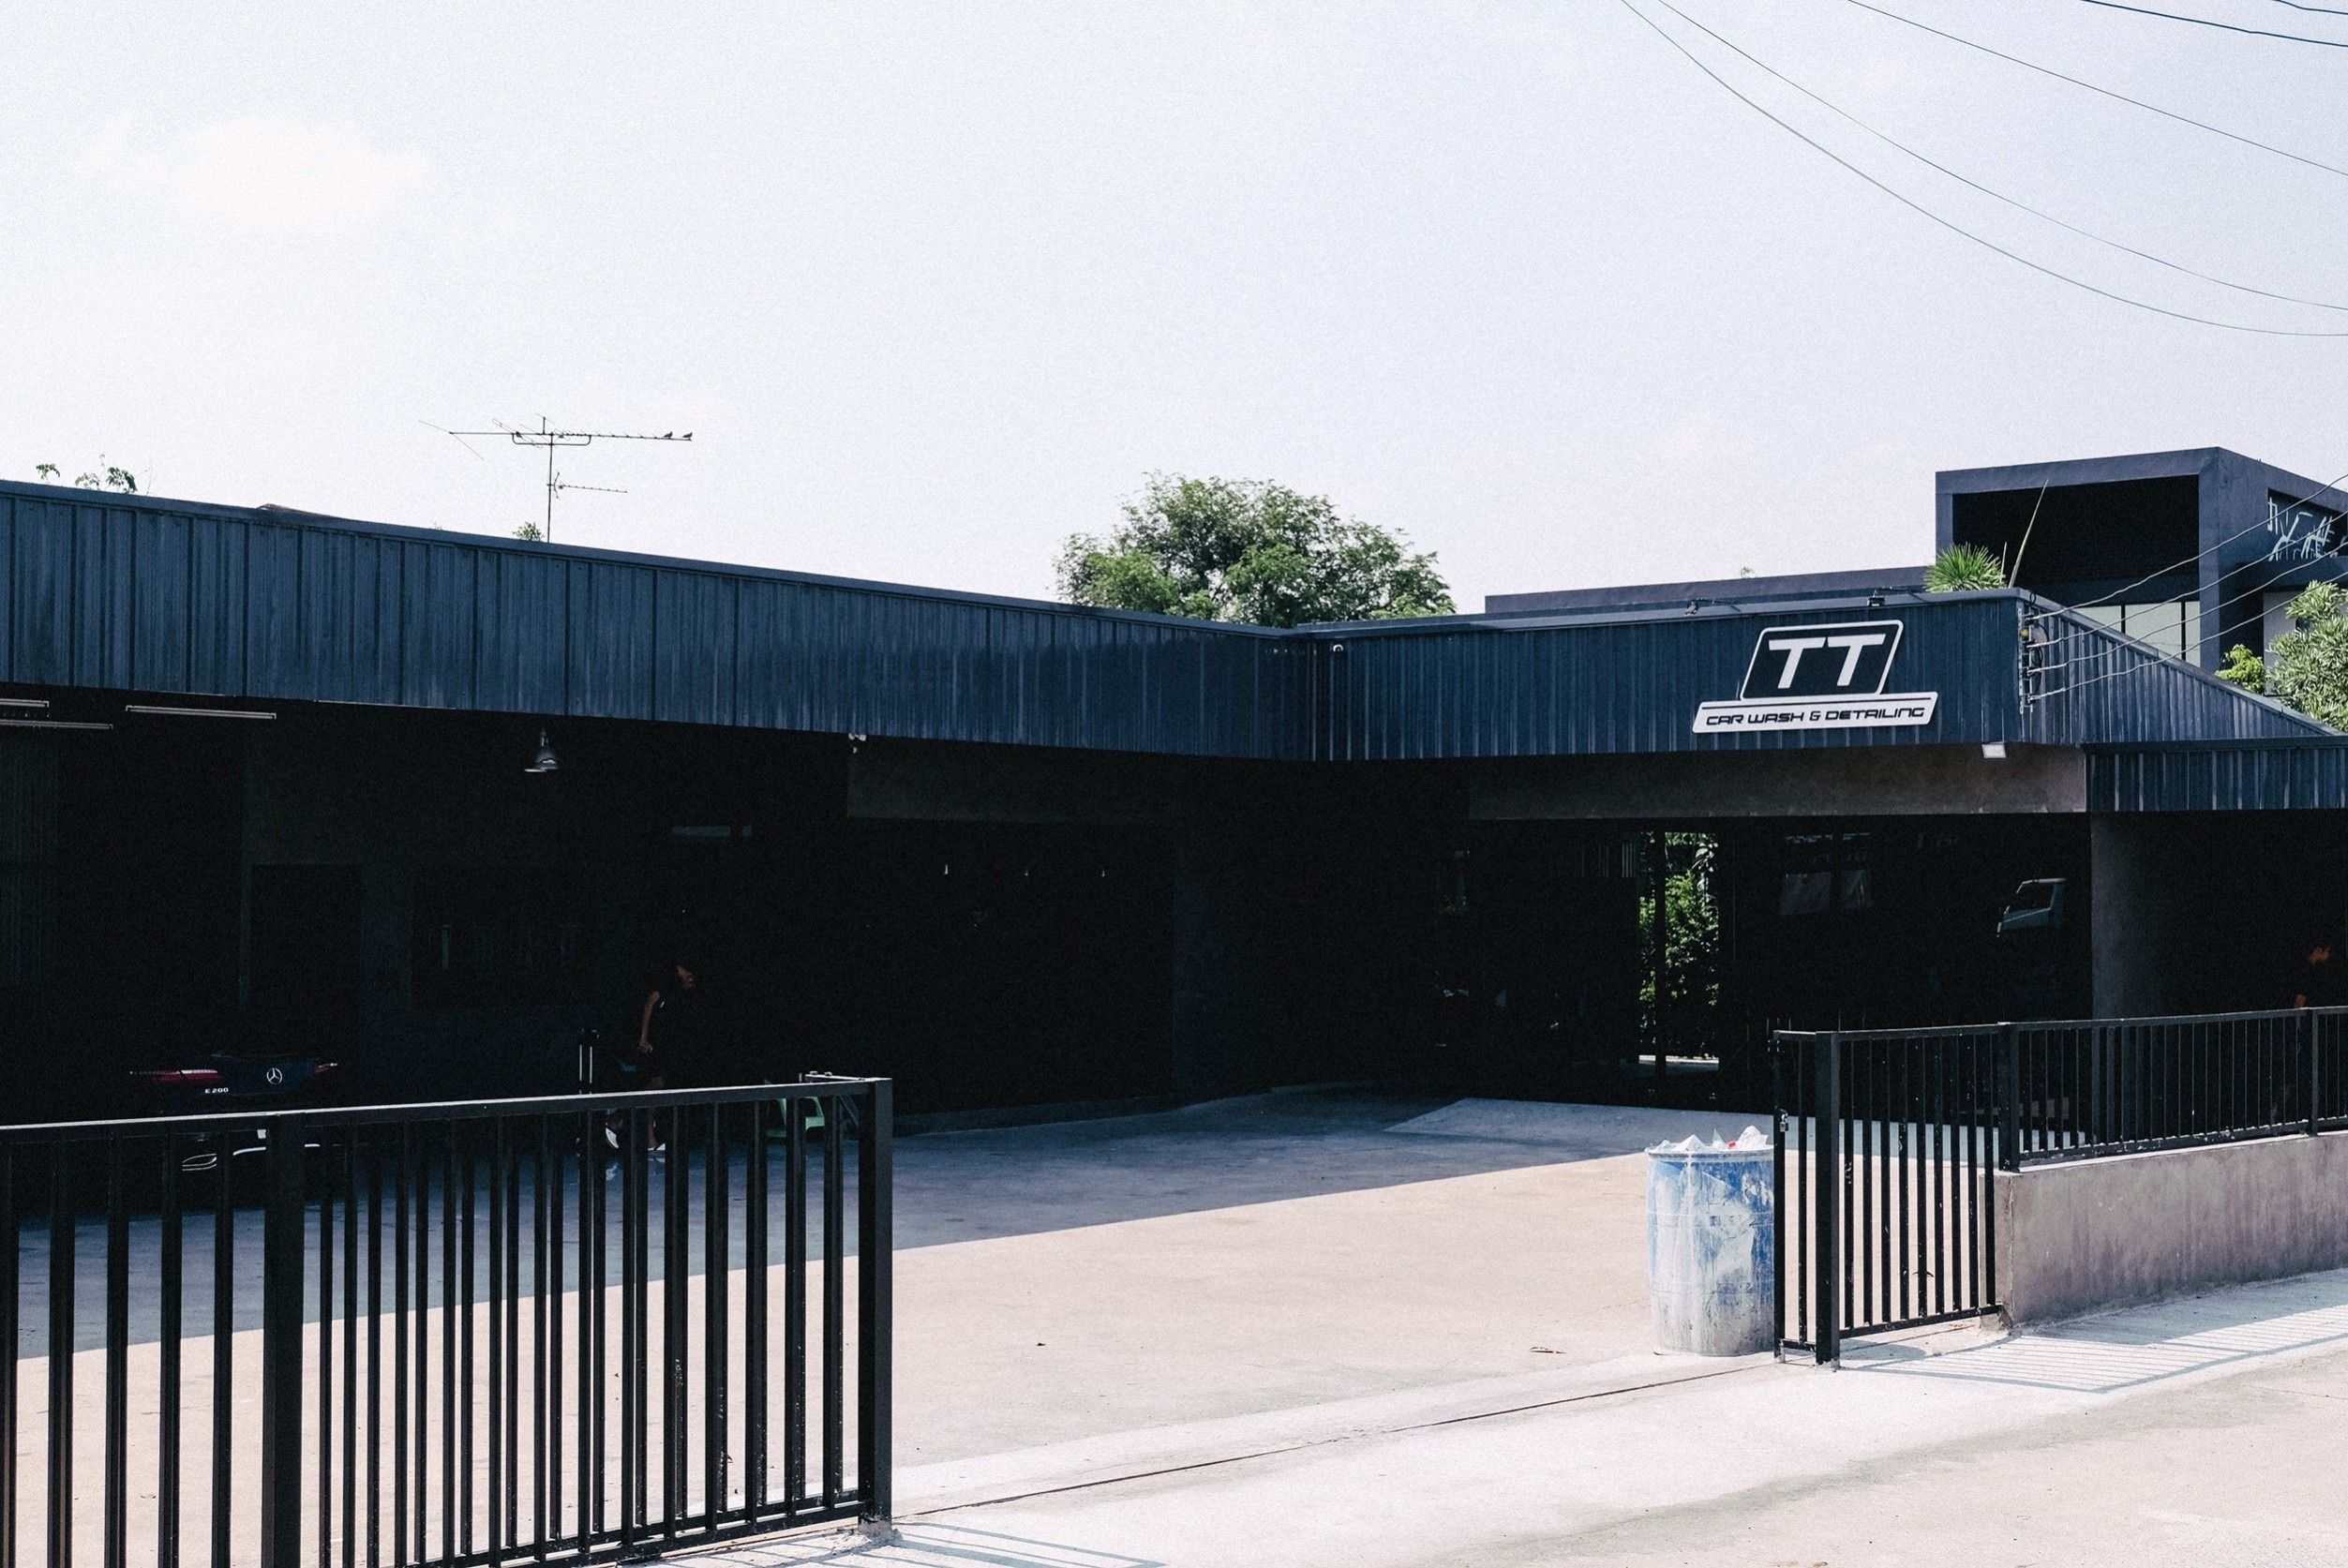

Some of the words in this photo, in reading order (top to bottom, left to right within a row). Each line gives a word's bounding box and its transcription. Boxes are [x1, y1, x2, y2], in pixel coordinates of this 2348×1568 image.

[1768, 633, 1887, 689] TT
[1706, 715, 1744, 726] CAR
[1747, 712, 1804, 724] WASH
[1809, 711, 1821, 721] &
[1824, 708, 1925, 721] DETAILING
